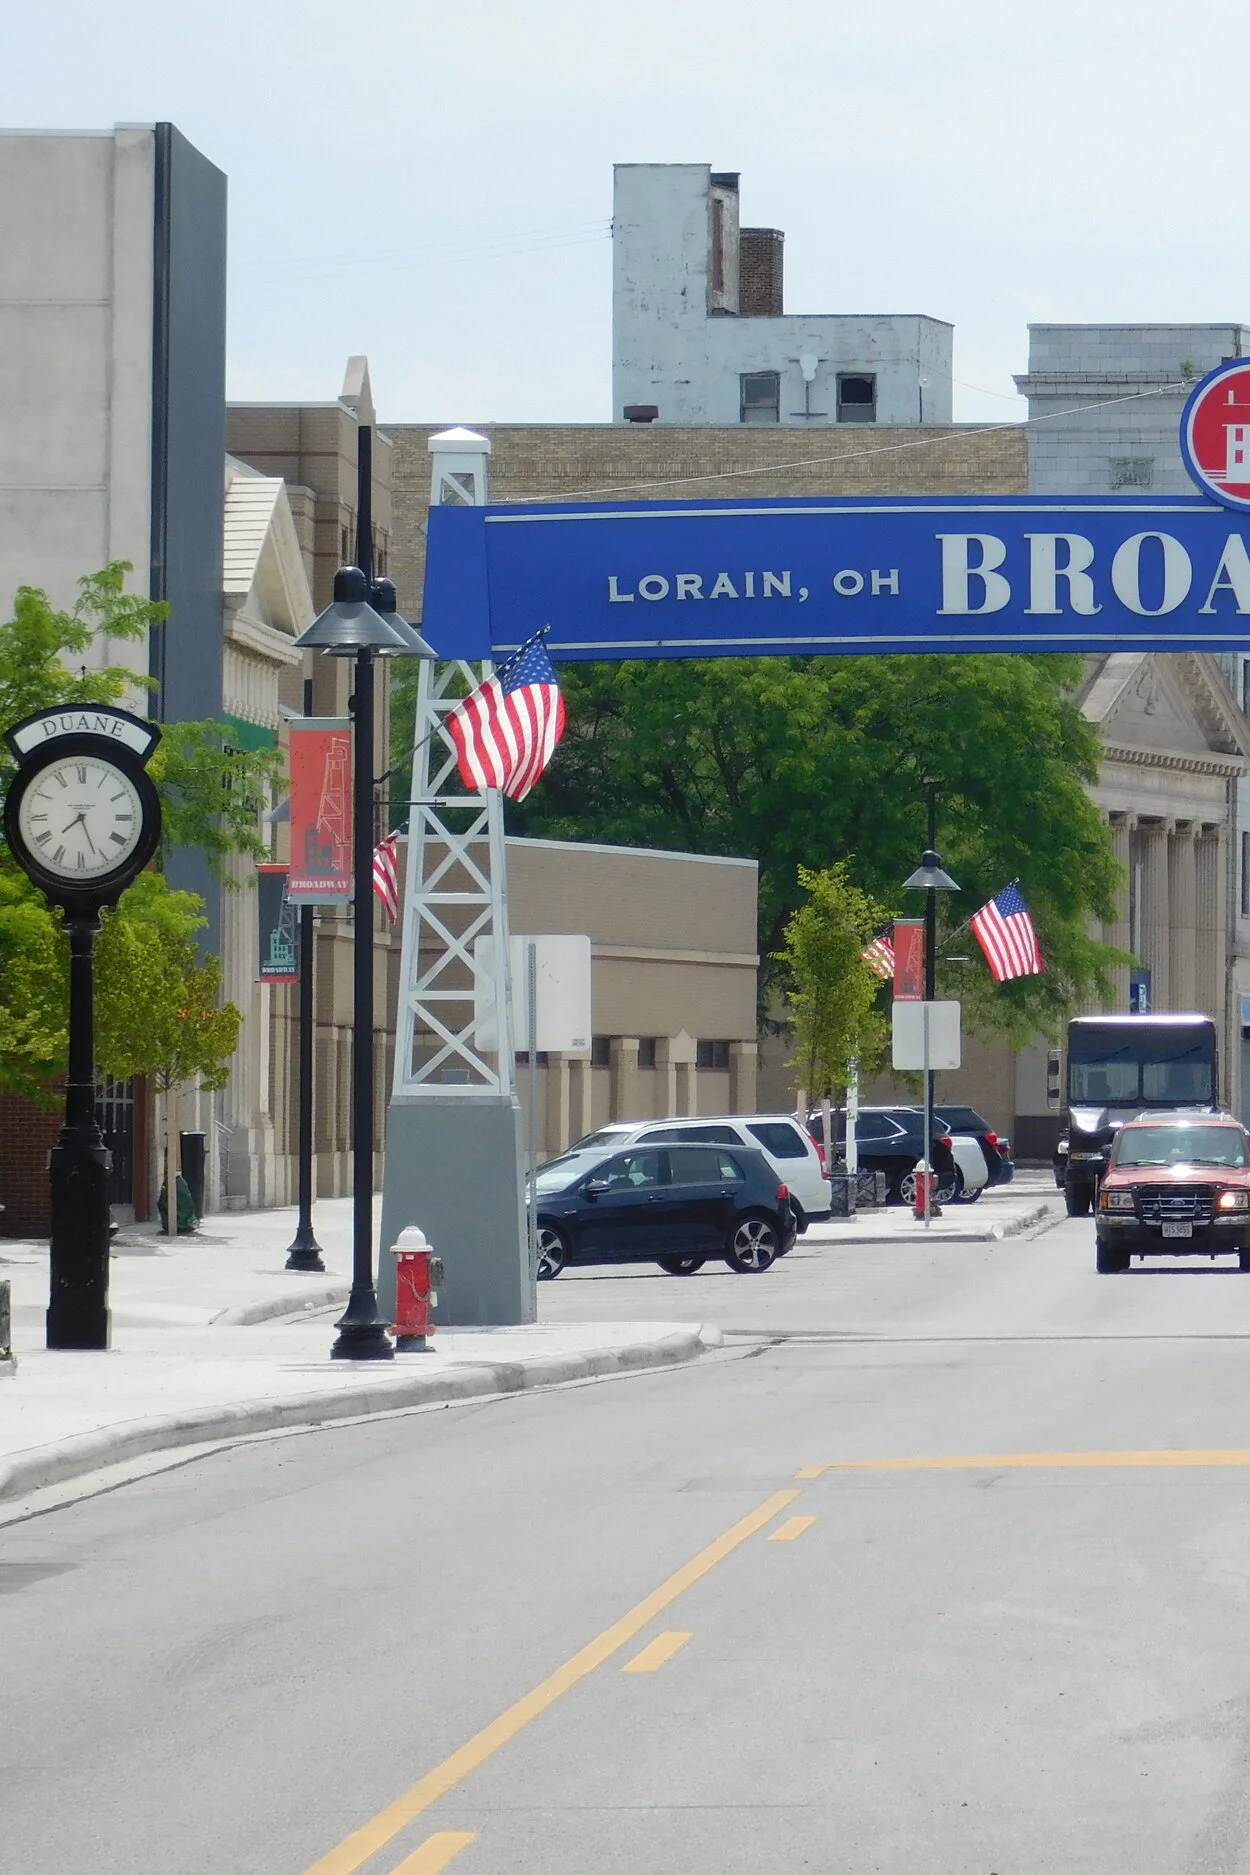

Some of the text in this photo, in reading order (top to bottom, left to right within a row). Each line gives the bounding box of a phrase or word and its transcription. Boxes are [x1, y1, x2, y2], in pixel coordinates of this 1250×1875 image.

[608, 570, 810, 603] LORAIN,
[832, 568, 900, 597] OH
[41, 714, 125, 738] DUANE
[291, 880, 348, 889] BROADWAY
